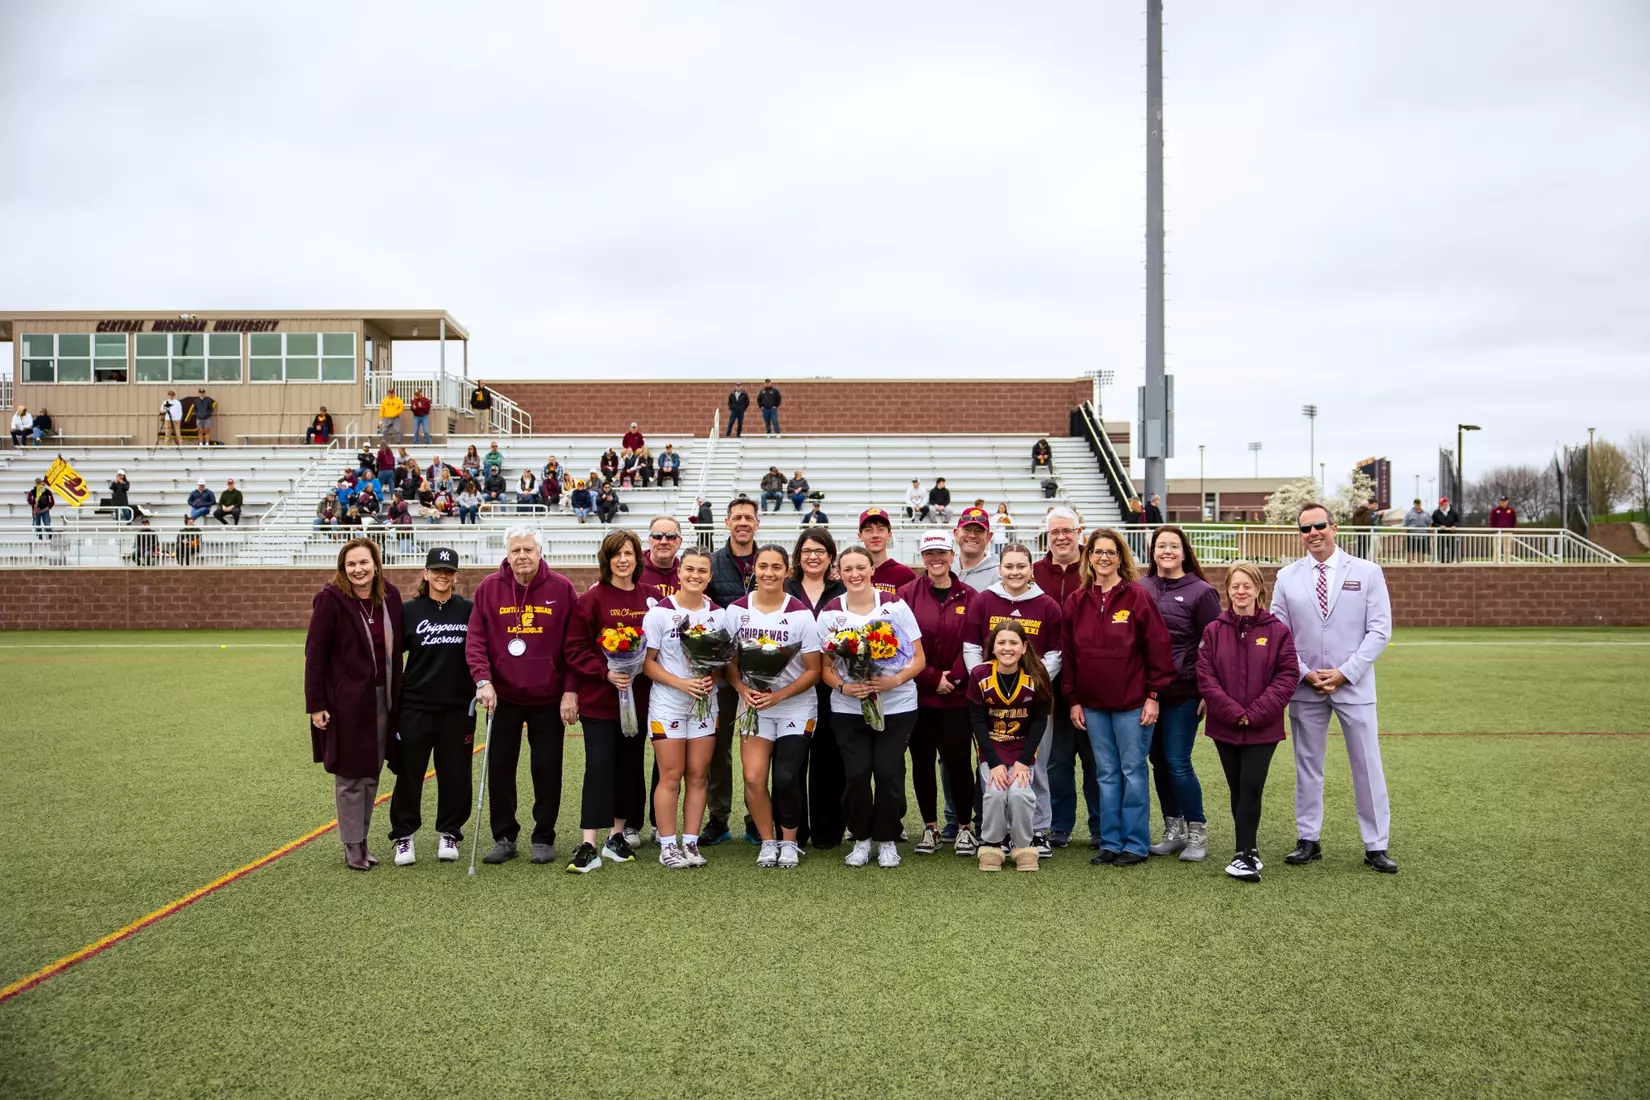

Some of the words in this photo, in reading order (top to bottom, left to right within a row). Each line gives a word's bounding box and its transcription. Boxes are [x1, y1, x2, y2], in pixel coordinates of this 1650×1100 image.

[95, 319, 145, 333] CENTRAL
[151, 319, 208, 333] MICHIGAN
[213, 319, 280, 333] UNIVERSITY
[439, 550, 451, 561] NY
[416, 619, 468, 635] Chippewa
[421, 634, 465, 646] Lacrosse
